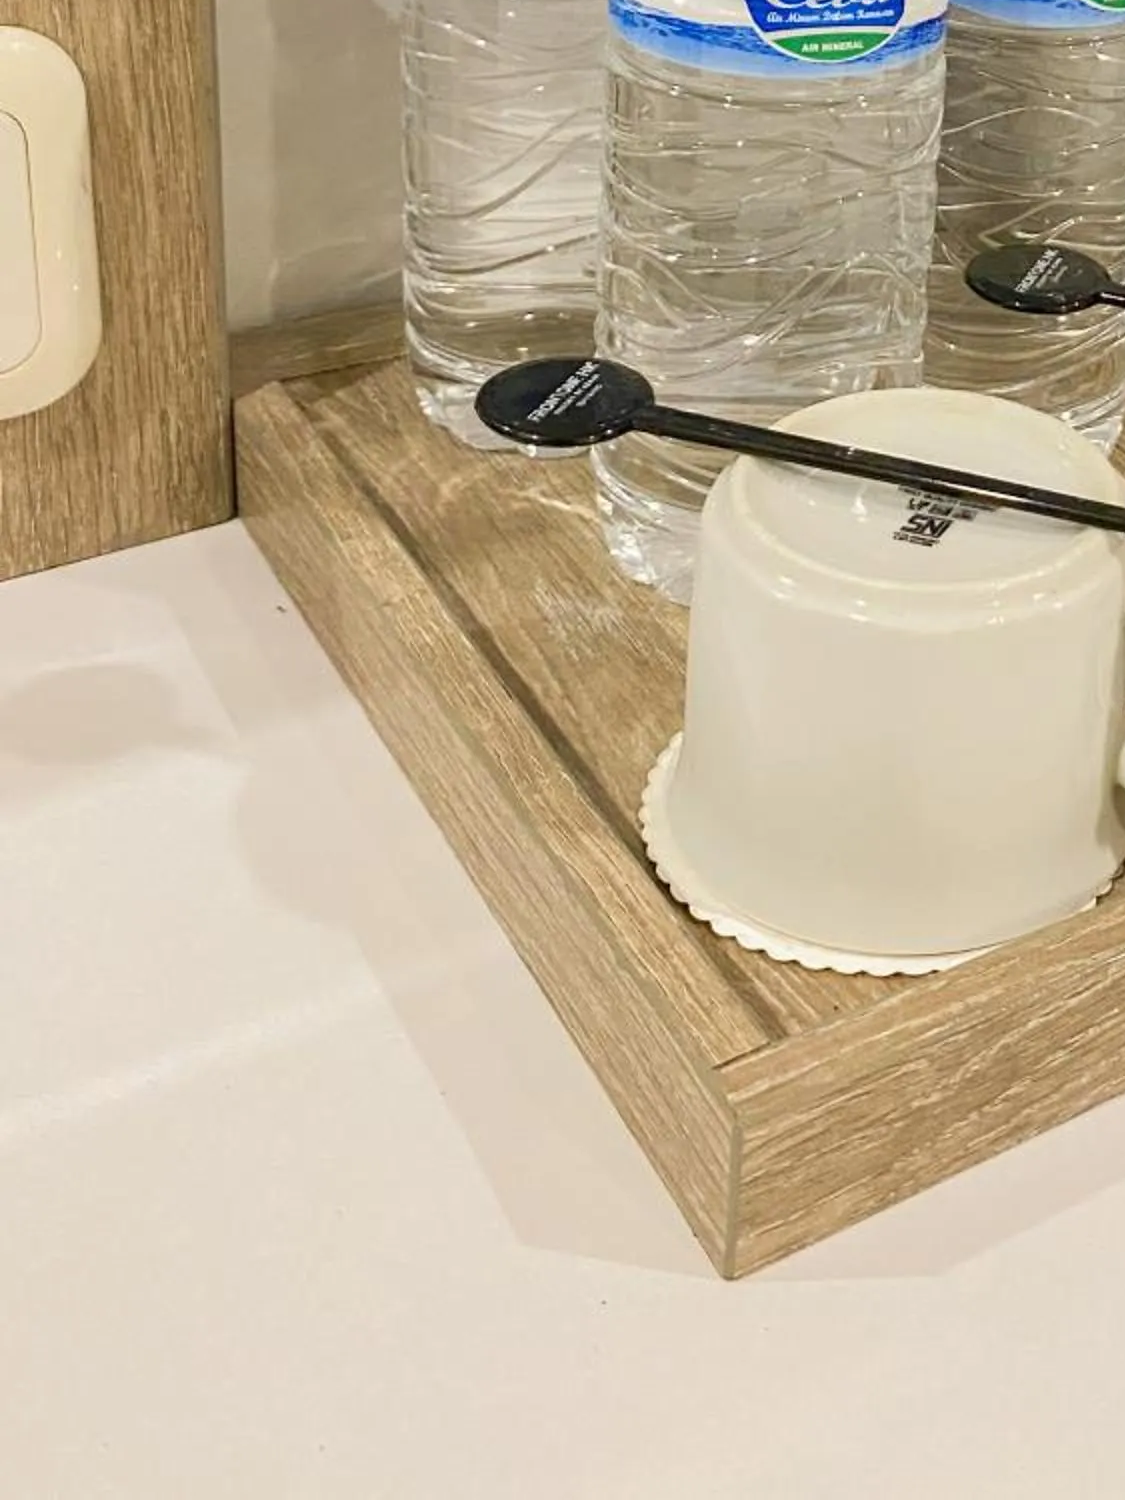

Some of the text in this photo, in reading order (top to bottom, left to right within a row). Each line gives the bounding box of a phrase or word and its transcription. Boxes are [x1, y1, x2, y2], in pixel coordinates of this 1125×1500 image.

[801, 40, 865, 53] AIR MINERAL
[900, 513, 954, 539] SNI
